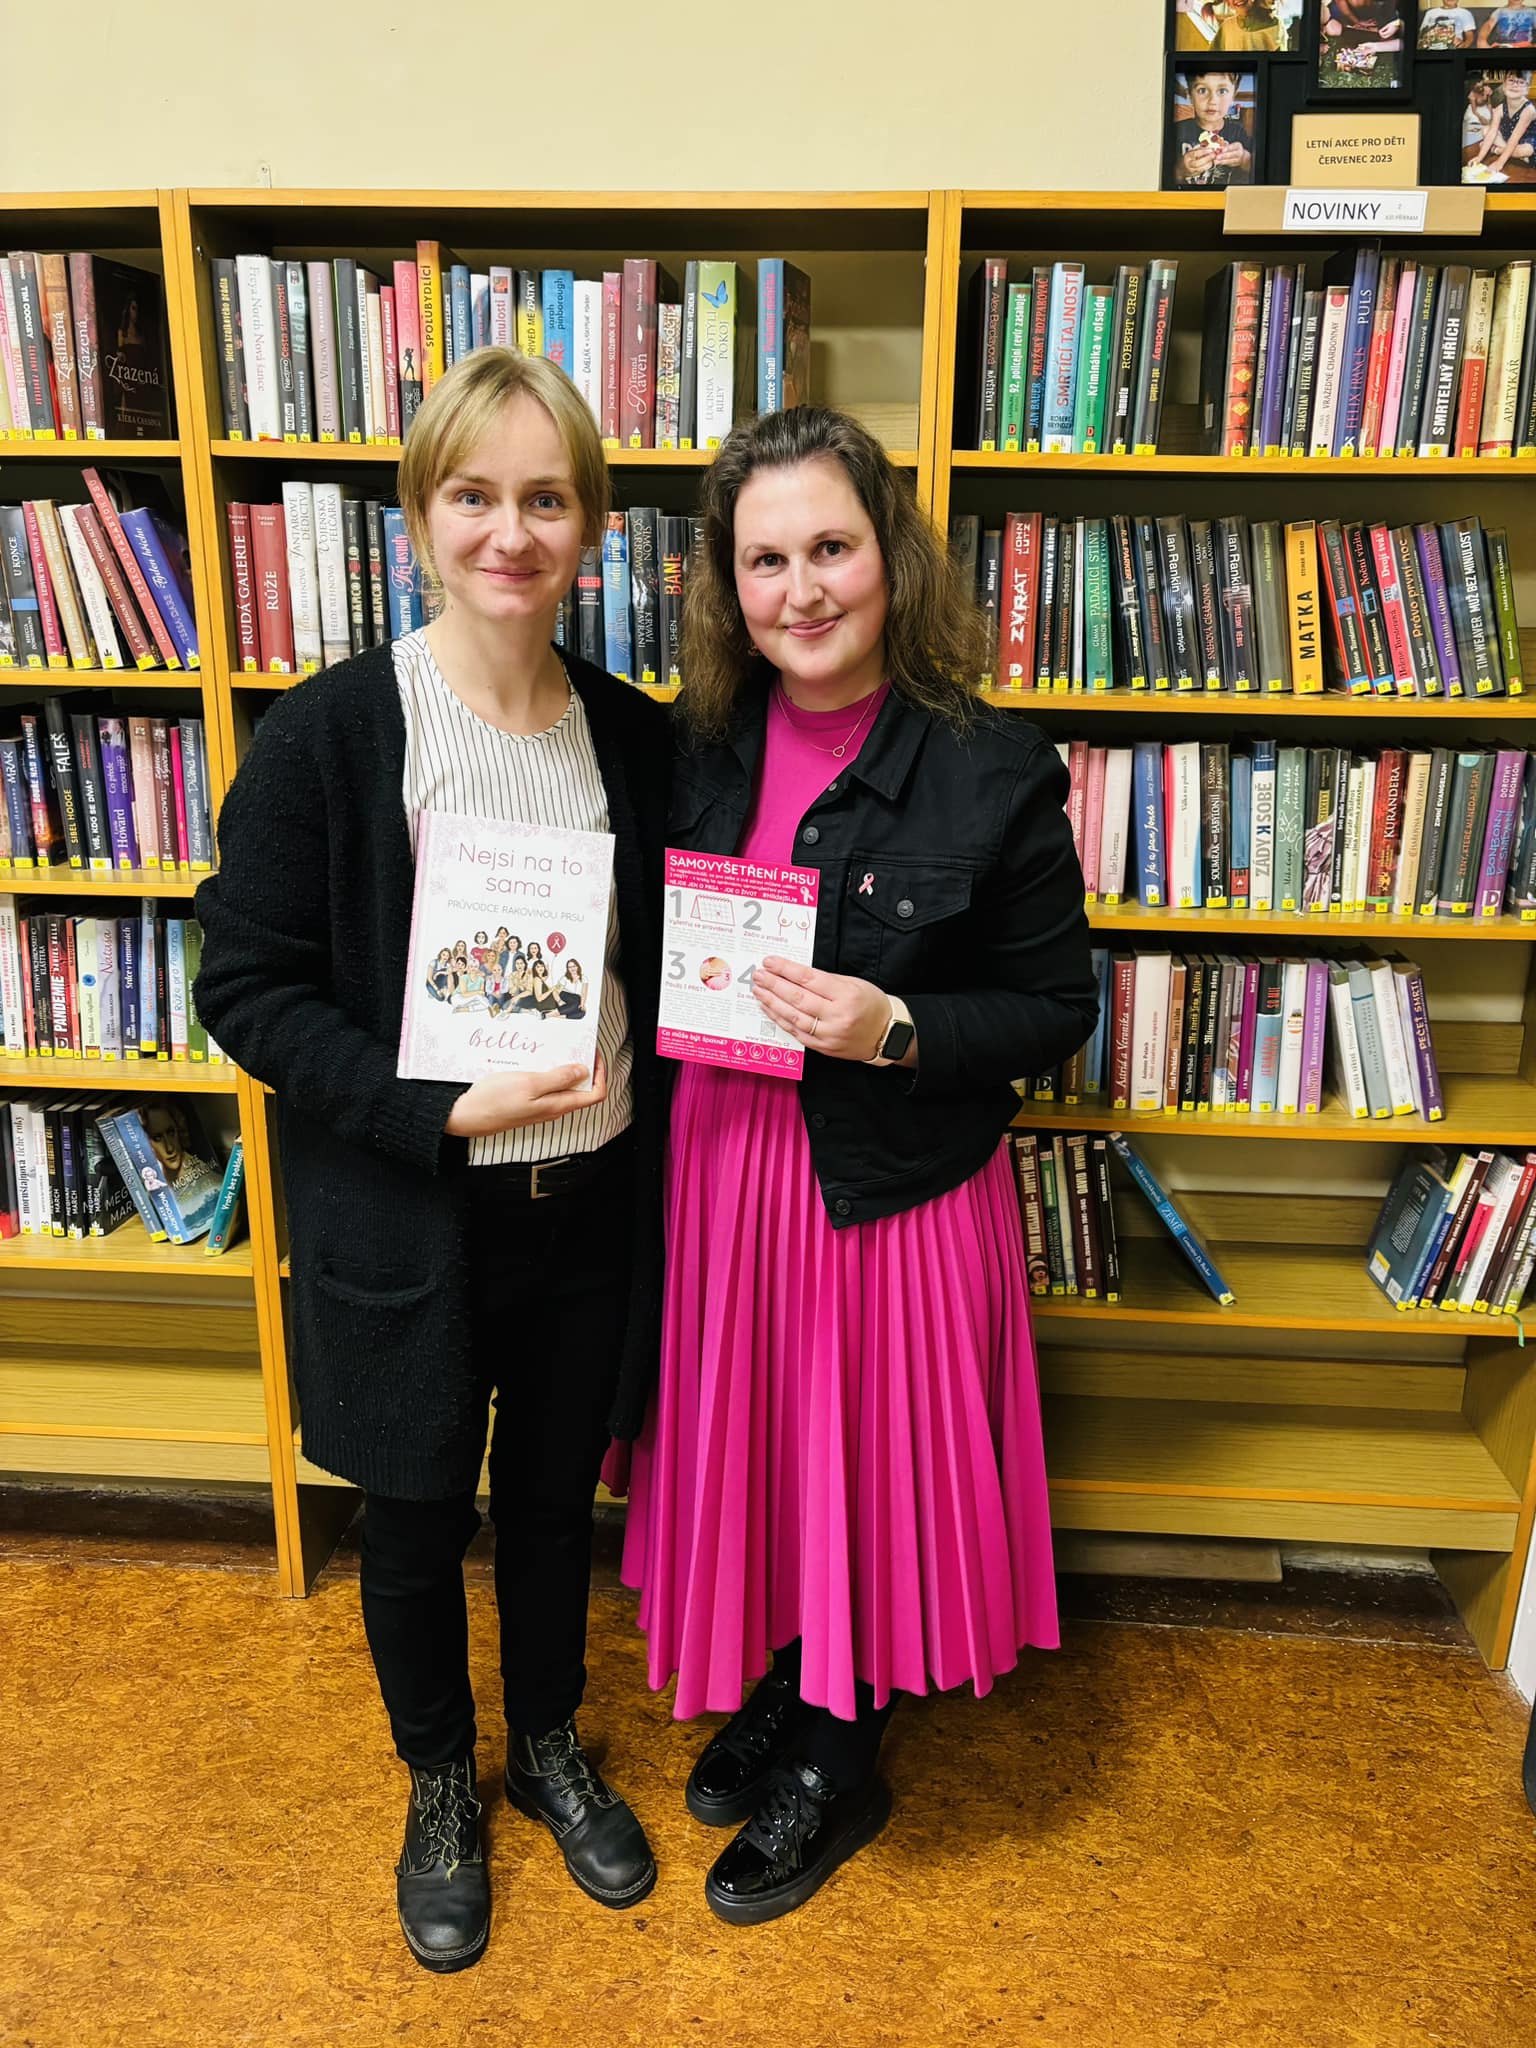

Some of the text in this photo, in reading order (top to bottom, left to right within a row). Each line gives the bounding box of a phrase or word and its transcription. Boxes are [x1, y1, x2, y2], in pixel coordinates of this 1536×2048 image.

[1306, 135, 1405, 149] LETNÍ AKCE PRO DĚTI
[1318, 152, 1392, 165] ČERVENEC 2023
[1292, 202, 1381, 220] NOVINKY
[525, 280, 536, 312] ZPÁTKY
[554, 278, 565, 330] pinborough
[1159, 297, 1169, 317] Tim
[546, 304, 555, 330] sarah
[662, 311, 678, 355] zloději
[1122, 275, 1139, 369] ROBERT CRAIS
[77, 320, 97, 383] Zrazená
[718, 320, 729, 360] POKOJ
[1029, 277, 1049, 428] JAN BAUER PRAŽSKÝ ROZPAROVAČ
[1056, 272, 1079, 407] SMRTÍCÍ TAJNOSTI
[1442, 318, 1460, 360] HŘÍCH
[105, 353, 159, 392] Zrazená
[628, 357, 638, 385] Temná
[765, 357, 776, 380] Small
[1010, 348, 1023, 379] policejní
[1087, 344, 1101, 396] Kriminálka
[1296, 316, 1318, 432] SEBASTIAN FITZEK ŠÍLENÁ HRA
[1323, 322, 1339, 409] VRAŽEDNÉ CHARDONNAY
[1346, 289, 1372, 429] FELIX PULS
[627, 353, 648, 414] Raven
[704, 377, 714, 421] LUCINDA
[717, 386, 725, 412] RILEY
[1009, 381, 1020, 393] 92.
[1432, 364, 1454, 436] SMRTELNÝ
[1503, 359, 1520, 423] APATYKÁŘ
[9, 537, 22, 576] U KONCE
[391, 534, 409, 563] osudy
[643, 525, 652, 561] SIMON
[1015, 523, 1023, 555] JOHN
[1376, 531, 1391, 578] Dvojí tvář
[663, 552, 682, 596] BANE
[1088, 530, 1100, 617] PADAJÍCÍ STÍNY
[1122, 548, 1132, 580] PARKER
[1166, 534, 1180, 593] Ian Rankin
[1228, 534, 1240, 593] Ian Rankin
[1357, 559, 1369, 586] Noční
[234, 535, 253, 645] RUDÁ GALERIE
[265, 571, 279, 611] RŮŽE
[1010, 568, 1030, 644] ZVRAT
[1399, 539, 1423, 638] Právo první noc
[1459, 531, 1489, 671] TIM WEAVER MUŽ BEZ MINULOST
[1297, 591, 1316, 660] MATKA
[1396, 651, 1407, 677] Helene
[24, 723, 36, 759] SAVANOU
[50, 733, 72, 774] FALEŠ
[4, 751, 18, 784] MRAK
[1501, 765, 1510, 798] DOROTHY
[1509, 763, 1520, 798] KOOMSON
[109, 784, 117, 794] Co
[1384, 767, 1400, 838] KURANDERA
[64, 789, 79, 843] SIBEL HODGE
[89, 804, 97, 814] SE
[116, 809, 129, 848] Howard
[158, 790, 171, 850] HANNAH HOWELL
[1144, 804, 1159, 832] Jones
[1255, 782, 1272, 877] ZÁDY SOBĚ
[459, 842, 582, 876] Nejsi na to
[670, 856, 778, 880] SAMOVYŠETŘENÍ
[781, 871, 816, 885] PRSU
[1210, 843, 1220, 881] SOUMRAK
[486, 876, 551, 898] sama
[669, 889, 682, 918] 1
[448, 899, 585, 922] PRŮVODCE RAKOVINOU PRSU
[742, 900, 763, 931] 2
[125, 969, 134, 990] Srdce
[667, 950, 686, 980] 3
[737, 964, 756, 992] 4
[51, 975, 68, 1033] PANDEMIE
[1411, 980, 1427, 1050] PEČEŤ SMRTI
[469, 1028, 545, 1054] Bellis
[1115, 1012, 1130, 1088] Astrid Veronika
[13, 1116, 24, 1134] roky
[1073, 1145, 1089, 1194] DAVID IRVING
[1158, 1206, 1184, 1233] ZEMĚ
